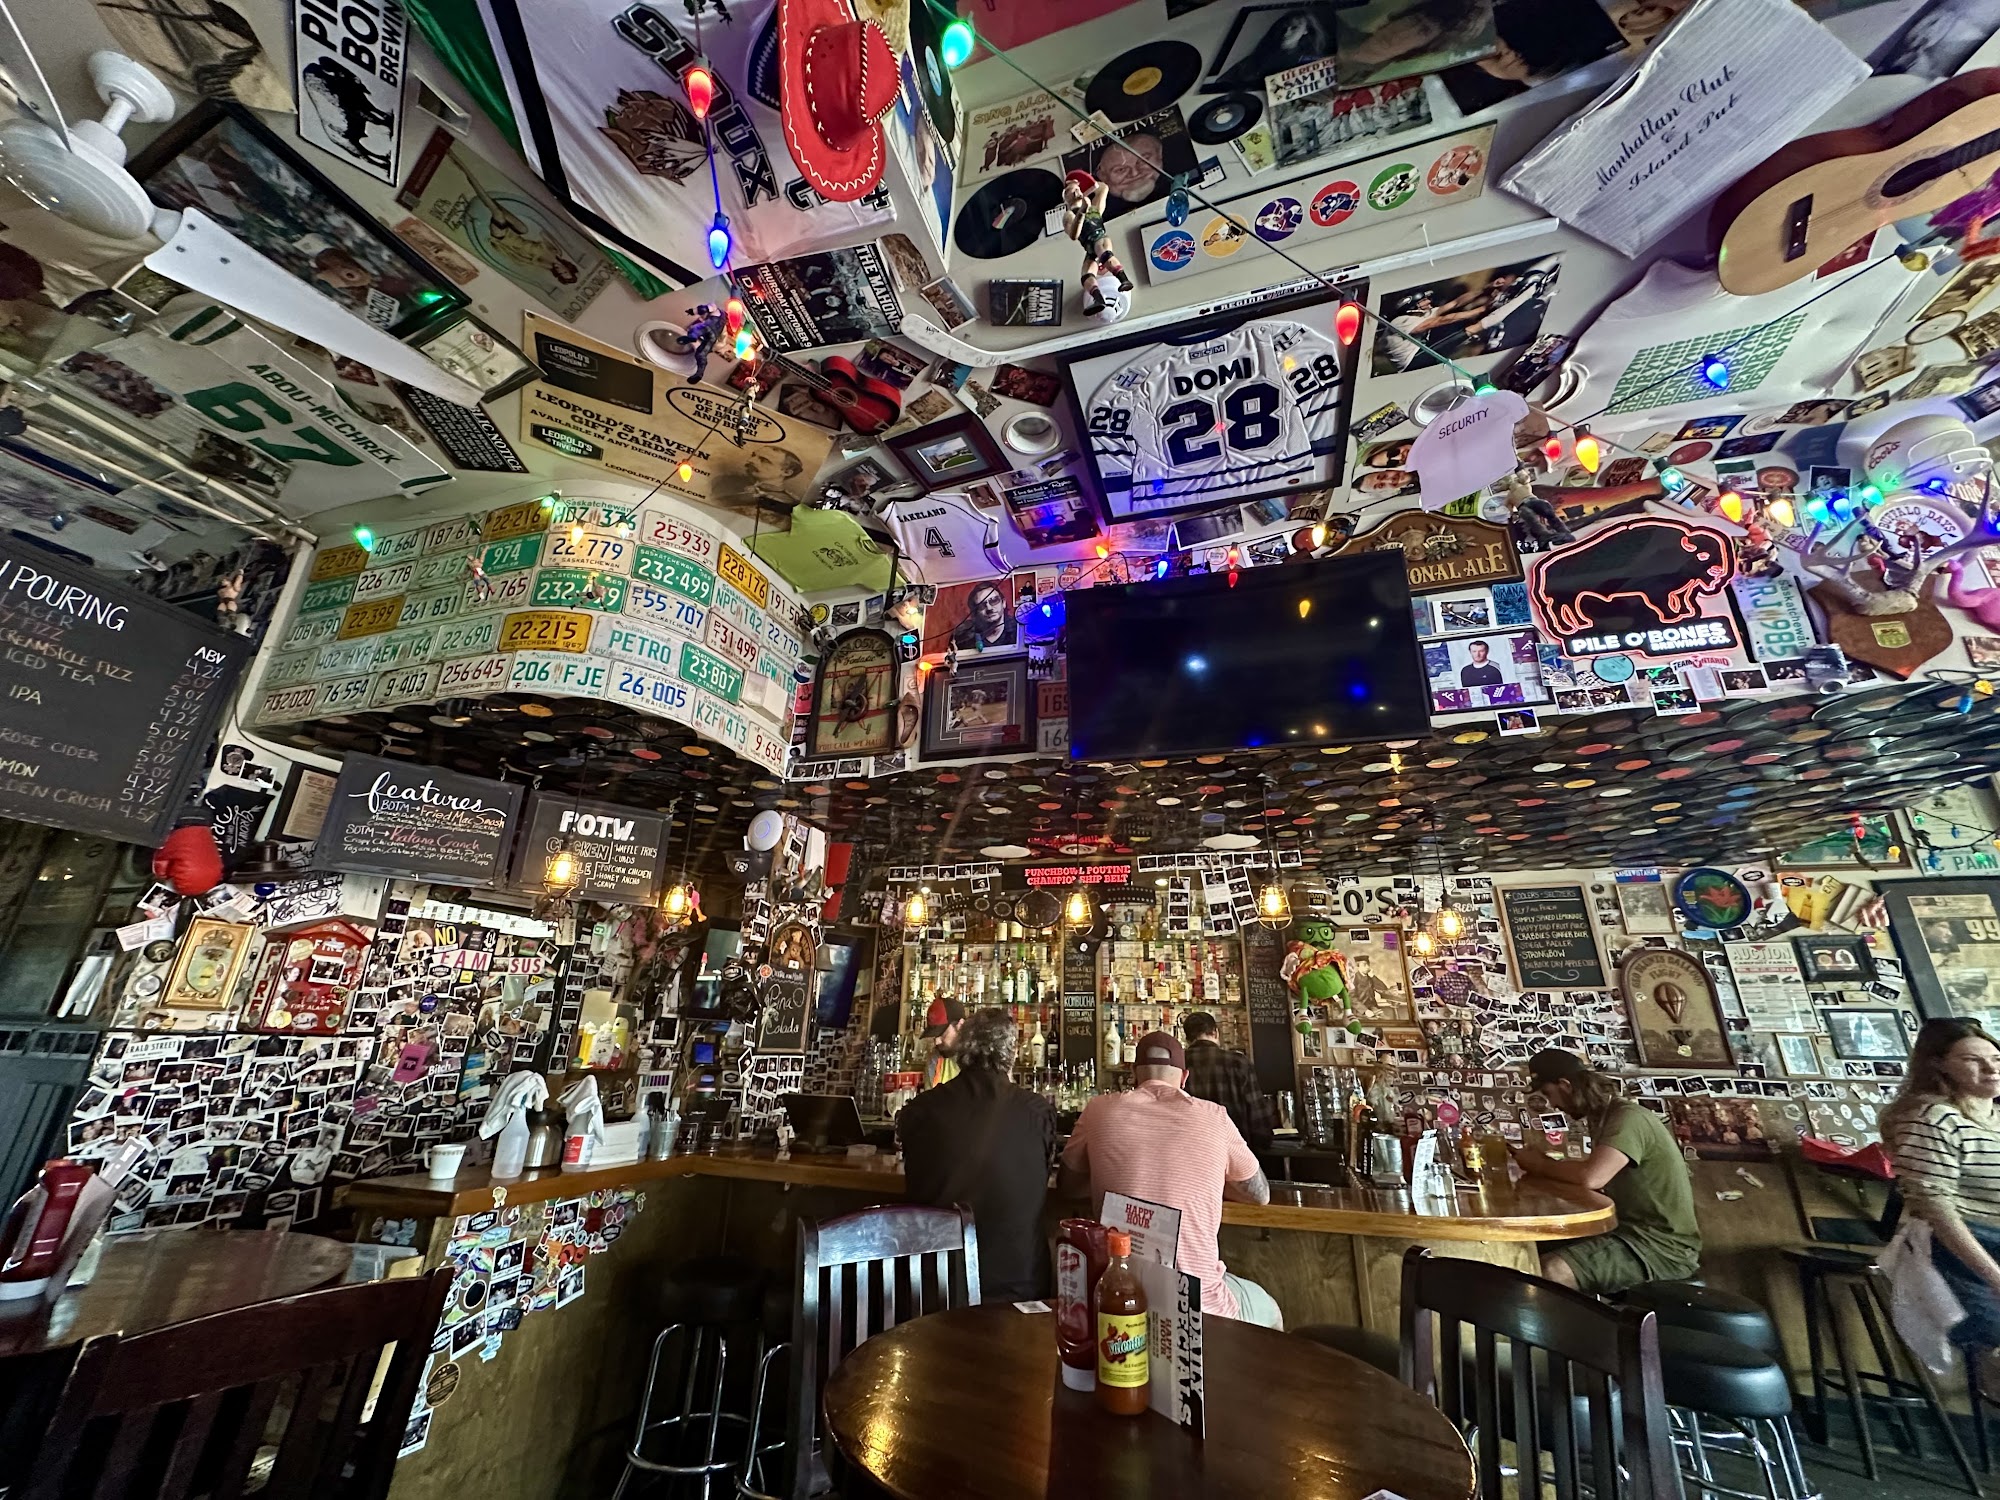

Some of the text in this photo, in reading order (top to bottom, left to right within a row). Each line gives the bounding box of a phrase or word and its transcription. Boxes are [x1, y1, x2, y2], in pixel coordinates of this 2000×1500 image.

[1283, 72, 1316, 90] SAM
[1298, 80, 1320, 96] THE
[973, 106, 1012, 126] SING
[1133, 107, 1174, 132] IVES
[1596, 64, 1738, 191] Manhattan Club
[1628, 92, 1743, 191] Island Pub
[855, 244, 879, 277] THE
[741, 276, 791, 348] DISTRIKT
[759, 264, 809, 343] THURSDAY OCTOBER
[1036, 288, 1054, 321] WAR
[1188, 343, 1227, 360] CCM
[1174, 358, 1252, 397] DOMI
[1288, 353, 1340, 396] 28
[681, 390, 714, 409] GIVE
[695, 403, 713, 416] OF
[183, 380, 366, 468] 67
[247, 364, 403, 466] ABOU-MECHREK
[533, 389, 712, 461] LEOPOLD'S TAVERN
[692, 410, 721, 424] AND
[1089, 405, 1133, 435] 28
[1160, 380, 1284, 468] 28
[1438, 407, 1489, 440] SECURITY
[529, 408, 629, 451] AVAILABLE IN ANY
[541, 427, 593, 453] LEOPOLD'S
[570, 414, 679, 458] GIFT CARDS
[490, 434, 524, 473] NOTICE
[551, 438, 583, 456] TAVERN
[604, 461, 707, 501] LEOPOLDSTAVERN.COM
[896, 507, 948, 524] LAKELAND
[1877, 505, 1957, 534] BUFFALO DAYS
[493, 543, 522, 566] 974
[923, 526, 956, 559] 4
[1463, 541, 1509, 578] ALE
[499, 576, 529, 598] 765
[1492, 585, 1526, 600] NIRVANA
[8, 564, 227, 666] POURING ABV
[743, 608, 765, 635] 142
[1778, 580, 1808, 648] Saskatchewan
[19, 616, 66, 642] FIZZ
[1571, 621, 1728, 654] PILE O'BONES
[1759, 618, 1796, 657] 985
[608, 629, 671, 665] PETRO
[1650, 638, 1707, 652] BREWING
[3, 645, 98, 687] ICED TEA
[96, 659, 135, 683] FIZZ
[512, 661, 606, 689] 206 FJE
[1672, 659, 1694, 672] TEAM
[8, 683, 43, 706] IPA
[724, 717, 747, 745] 413
[50, 741, 100, 763] CIDER
[833, 741, 851, 750] CALL
[52, 787, 112, 813] CRUSH
[347, 770, 508, 819] features
[379, 799, 411, 812] BOTM
[419, 803, 453, 822] Fried
[453, 811, 475, 828] Mac
[344, 823, 376, 838] SOTM
[615, 844, 659, 859] WAFFLE FRIES
[598, 873, 620, 883] HONEY
[1024, 865, 1132, 878] PUNCHBOWL POUTINE
[1103, 874, 1129, 884] BELT
[596, 880, 617, 890] GRAVY
[434, 925, 458, 947] NO
[1965, 919, 2000, 941] 99
[510, 957, 542, 975] SUS
[1521, 949, 1566, 960] STRONGBOW
[1732, 947, 1793, 962] AUCTION
[880, 959, 899, 979] $4
[307, 1004, 330, 1012] ALARM
[1063, 995, 1096, 1008] KOMBUCHA
[764, 1015, 800, 1036] Colada
[1066, 1025, 1092, 1037] GINGER
[150, 1040, 178, 1052] STREET
[427, 1061, 452, 1077] Bitch
[1124, 1203, 1155, 1221] HAPPY
[1126, 1212, 1151, 1229] HOUR
[1176, 1272, 1193, 1427] SPECIALS
[1188, 1306, 1204, 1400] DAILY
